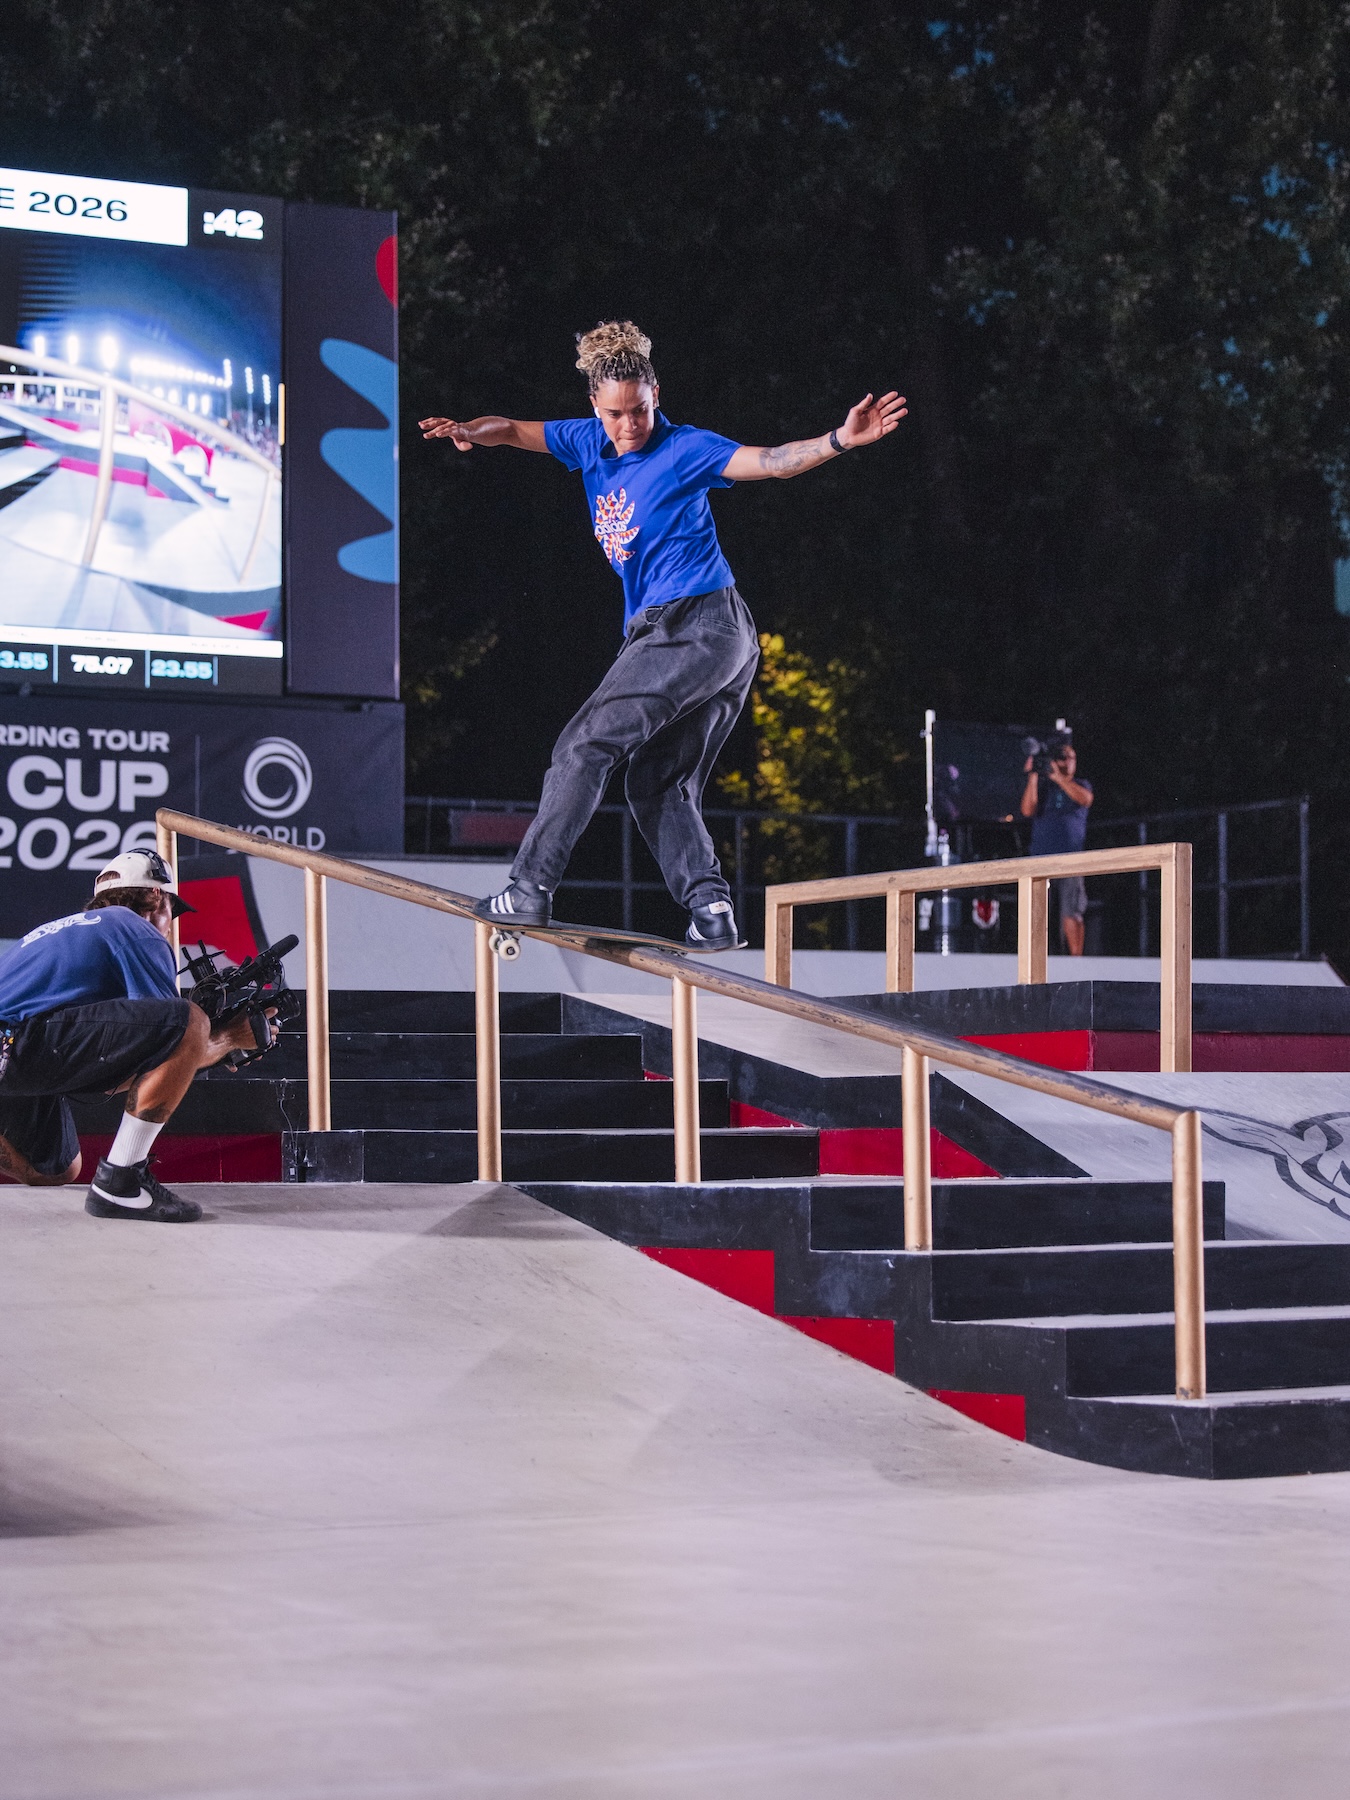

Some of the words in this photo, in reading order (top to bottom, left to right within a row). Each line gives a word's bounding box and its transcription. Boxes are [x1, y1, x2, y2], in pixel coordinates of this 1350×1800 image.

[29, 191, 128, 221] 2026
[203, 208, 264, 240] :42
[151, 658, 213, 680] 23.55
[87, 728, 170, 753] TOUR
[7, 755, 169, 812] CUP
[224, 824, 326, 852] ORLD
